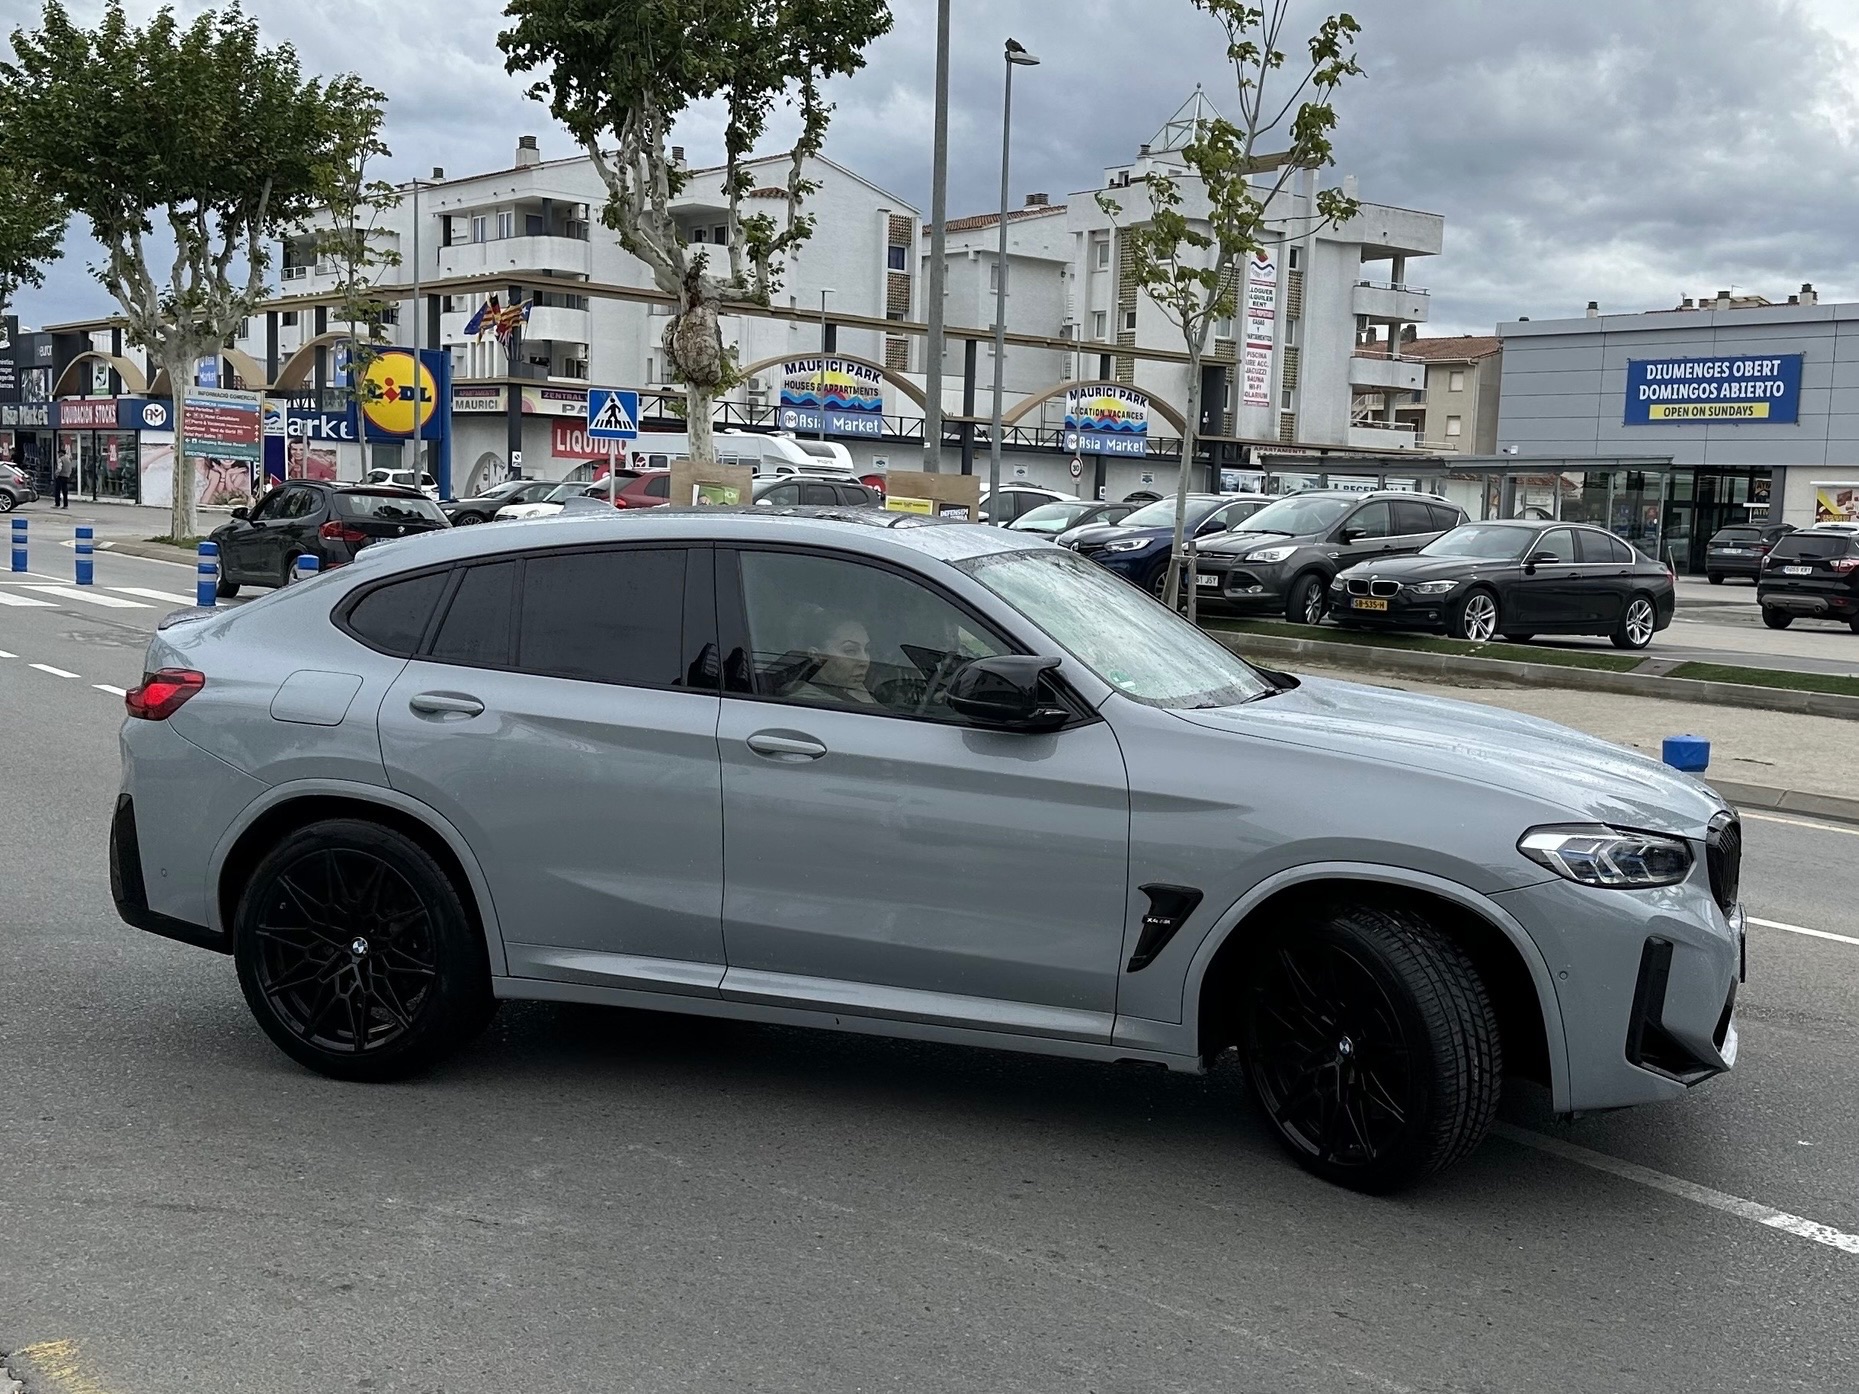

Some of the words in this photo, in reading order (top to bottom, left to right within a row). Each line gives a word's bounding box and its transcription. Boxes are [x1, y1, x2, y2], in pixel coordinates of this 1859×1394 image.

[784, 360, 842, 375] MAURICI
[846, 363, 881, 384] PARK
[1646, 362, 1730, 380] DIUMENGES
[1732, 360, 1781, 377] OBERT
[543, 391, 584, 401] ZENTRAL
[784, 380, 815, 392] HOUSES
[816, 383, 822, 392] &
[824, 383, 879, 396] APPARTMENTS
[1244, 391, 1268, 399] OLARIUM
[1639, 382, 1718, 400] DOMINGOS
[1720, 381, 1785, 398] ABIERTO
[455, 400, 498, 410] MAURICI
[1069, 387, 1116, 401] MAURICI
[1119, 390, 1148, 408] PARK
[95, 404, 117, 424] STOCKS
[1107, 409, 1144, 420] VACANCES
[1663, 406, 1689, 417] OPEN
[1691, 406, 1706, 417] ON
[1708, 405, 1754, 416] SUNDAYS
[288, 415, 354, 439] arke
[833, 417, 879, 433] Market
[1079, 436, 1101, 448] Asia
[1106, 438, 1144, 453] Market
[1253, 446, 1307, 454] APARTAMENTS
[1072, 464, 1080, 472] 30
